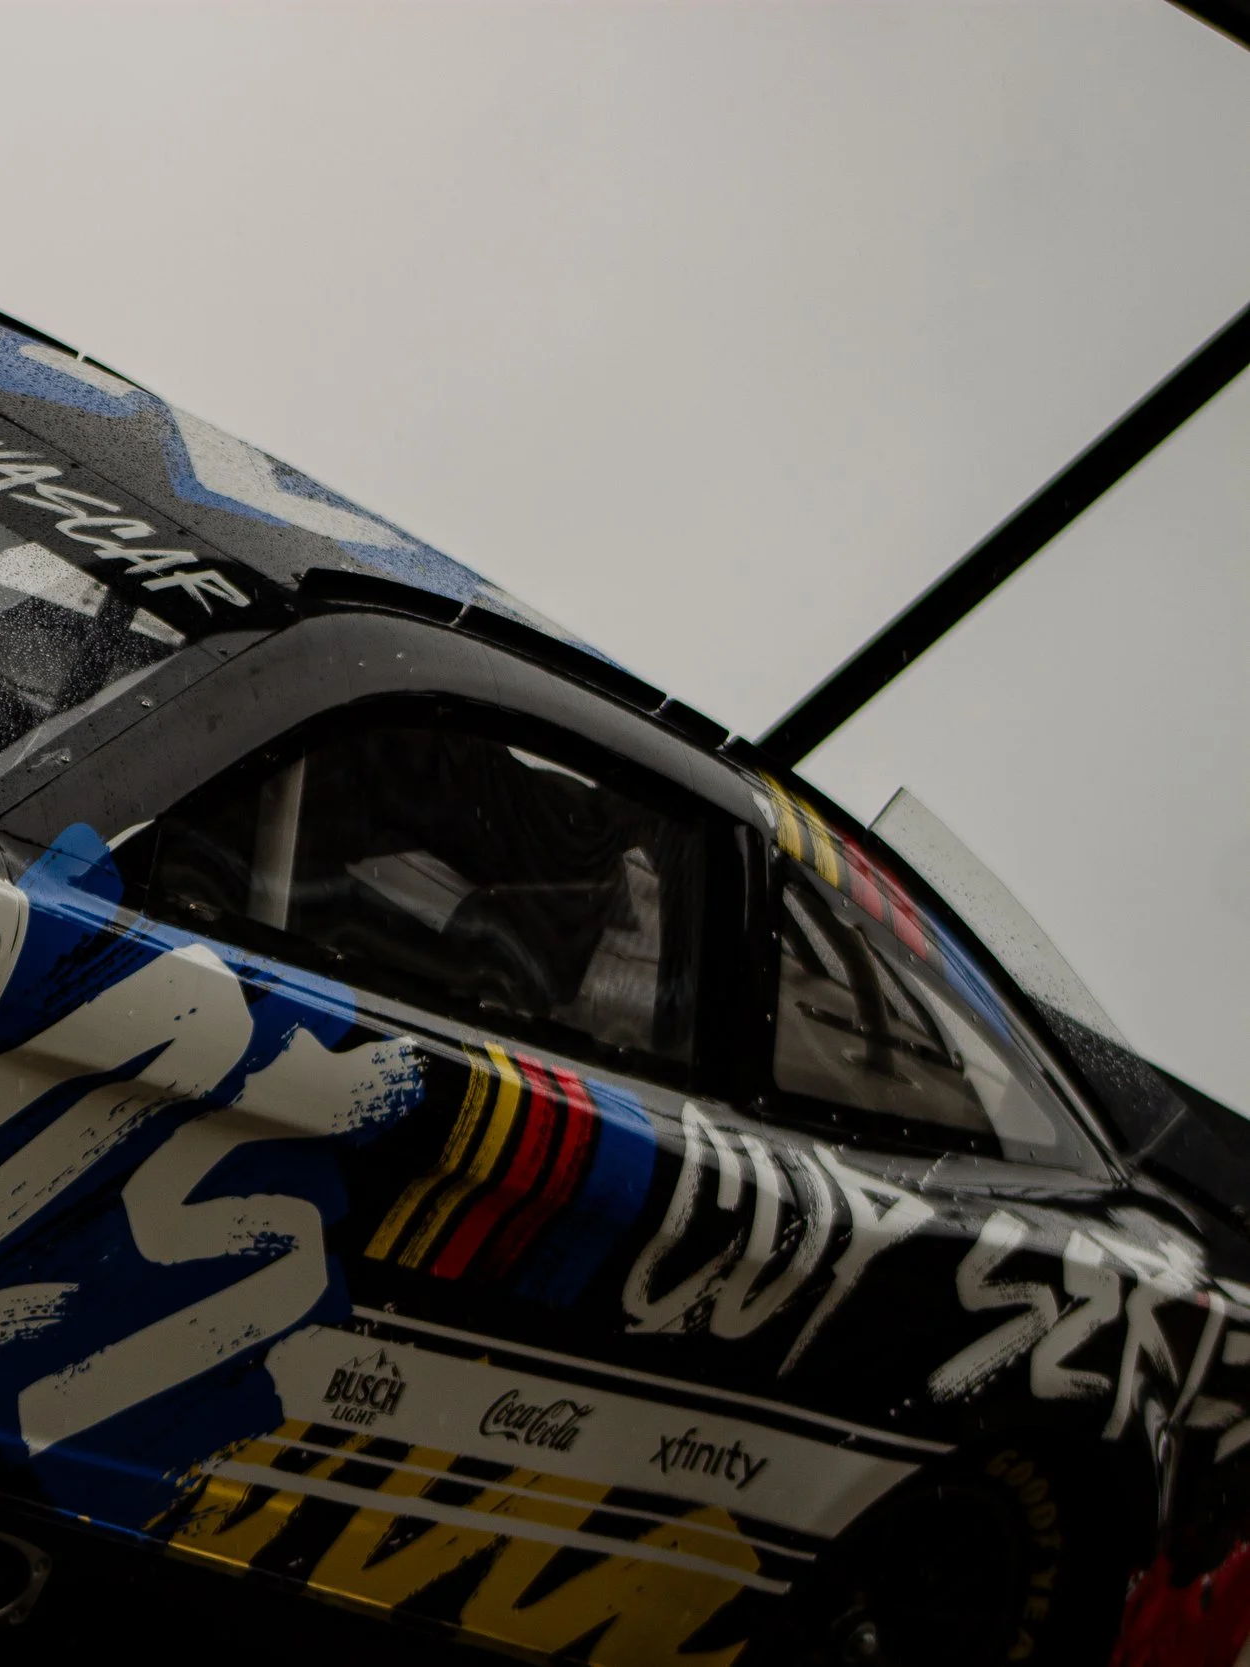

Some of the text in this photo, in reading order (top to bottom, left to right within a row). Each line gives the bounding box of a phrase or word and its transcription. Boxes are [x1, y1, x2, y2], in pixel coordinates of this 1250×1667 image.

[622, 1101, 934, 1380] CUP
[325, 1368, 405, 1413] BUSCH
[330, 1404, 374, 1426] LIGHT
[479, 1389, 595, 1452] Coca-Cola
[649, 1428, 767, 1489] xfinity
